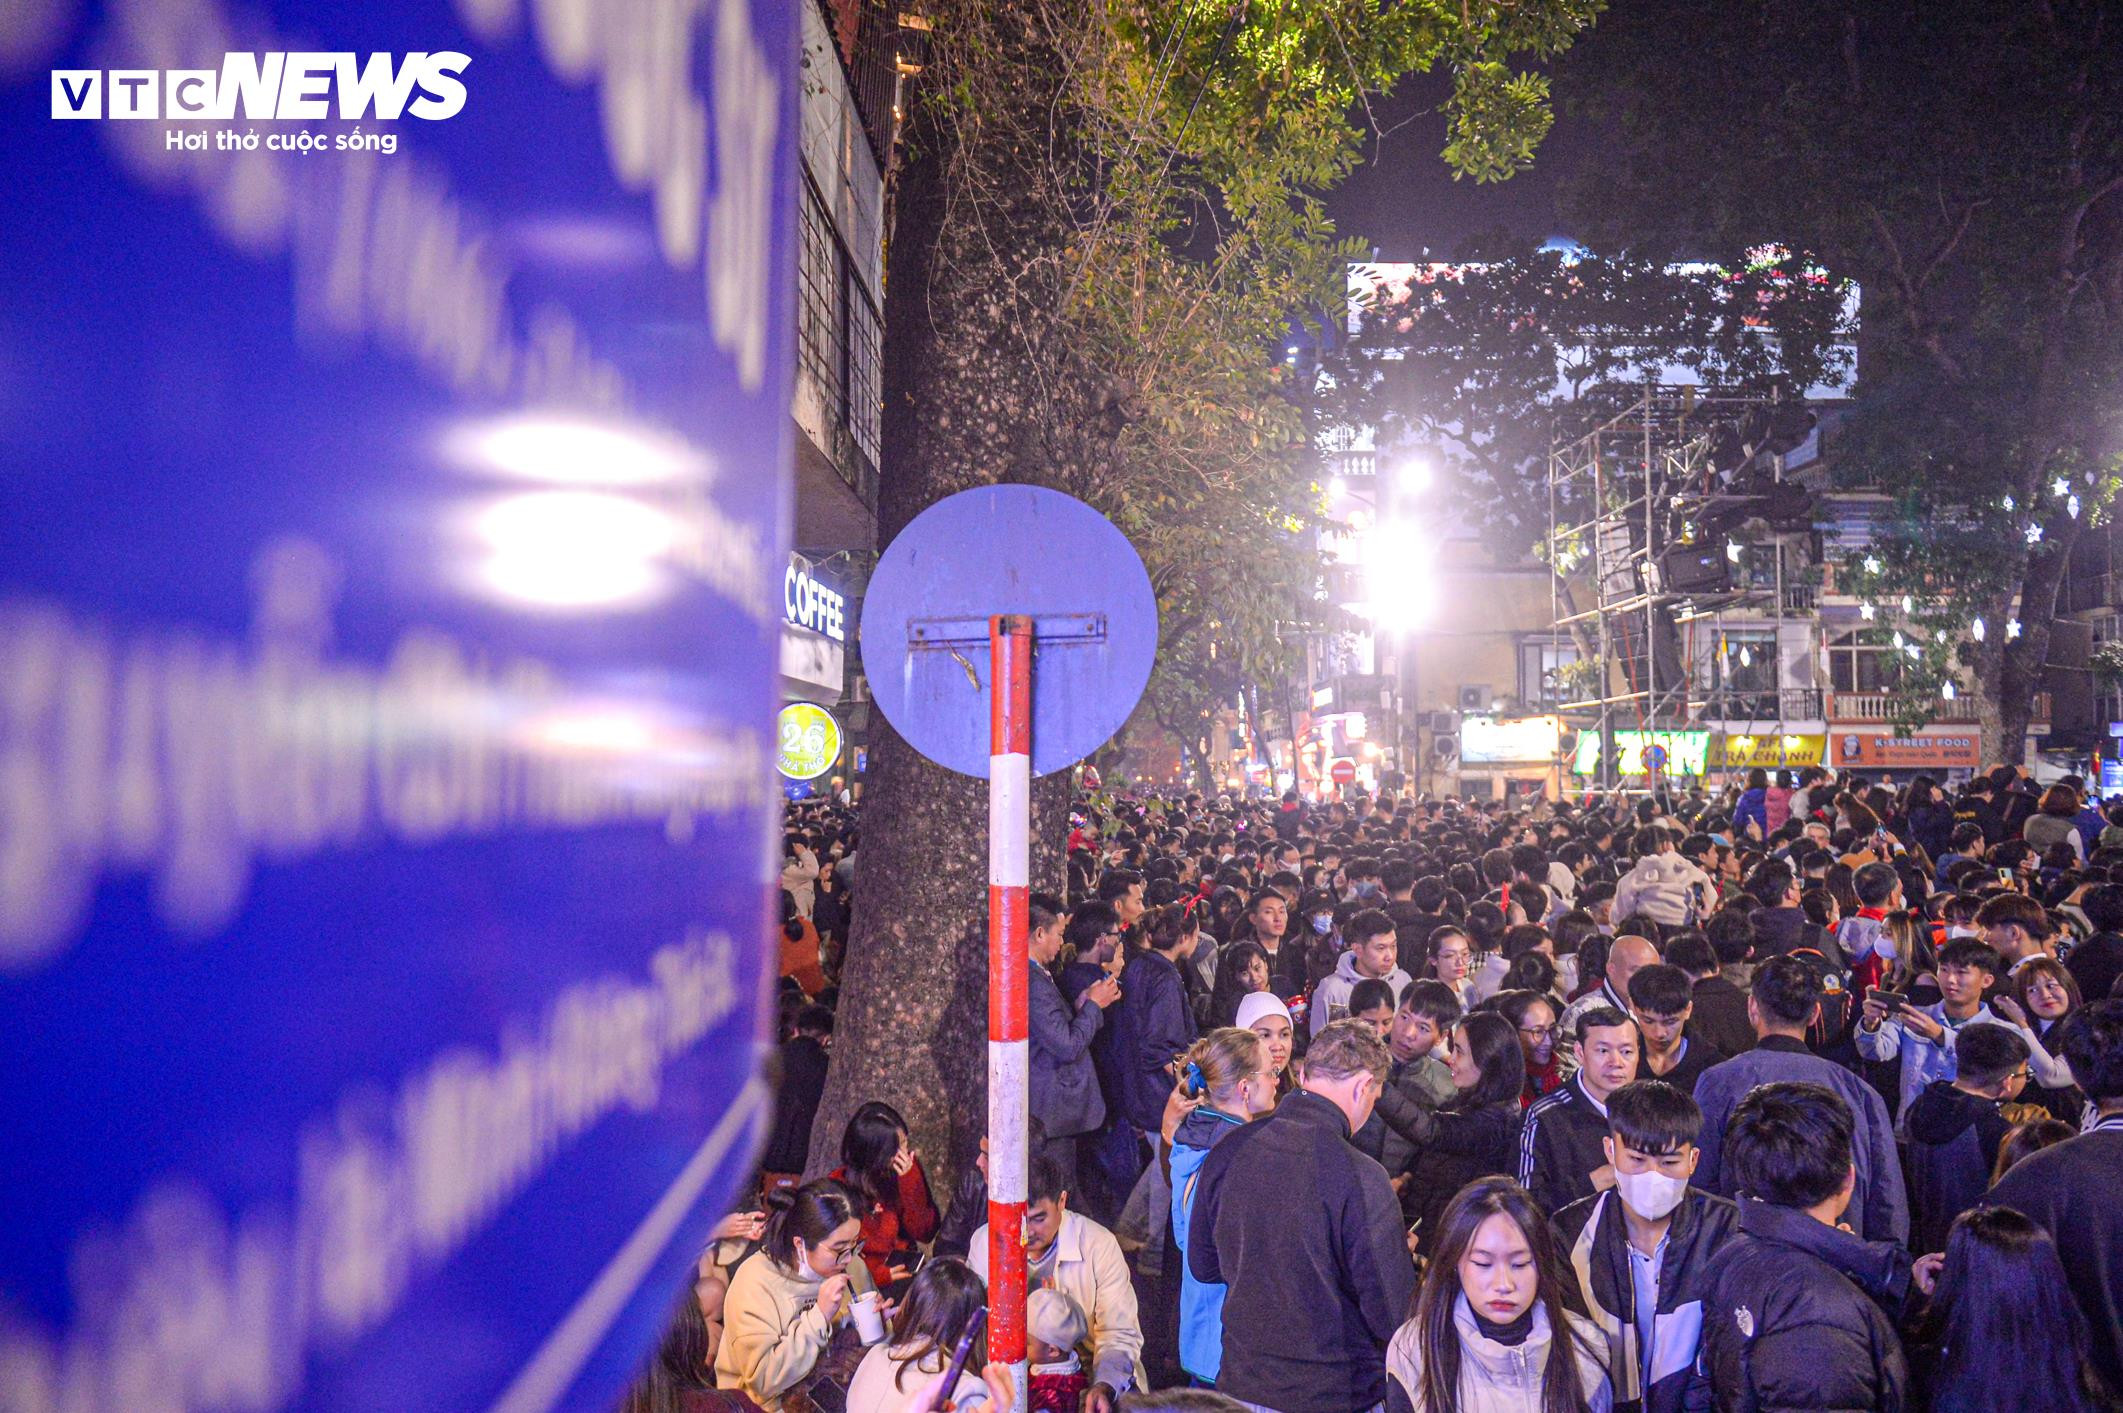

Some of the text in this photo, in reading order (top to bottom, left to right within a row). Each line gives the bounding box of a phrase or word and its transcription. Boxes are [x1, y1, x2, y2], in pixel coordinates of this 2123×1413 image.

[785, 565, 844, 641] COFFEE
[783, 723, 824, 754] 26
[1936, 737, 1971, 748] FOOD
